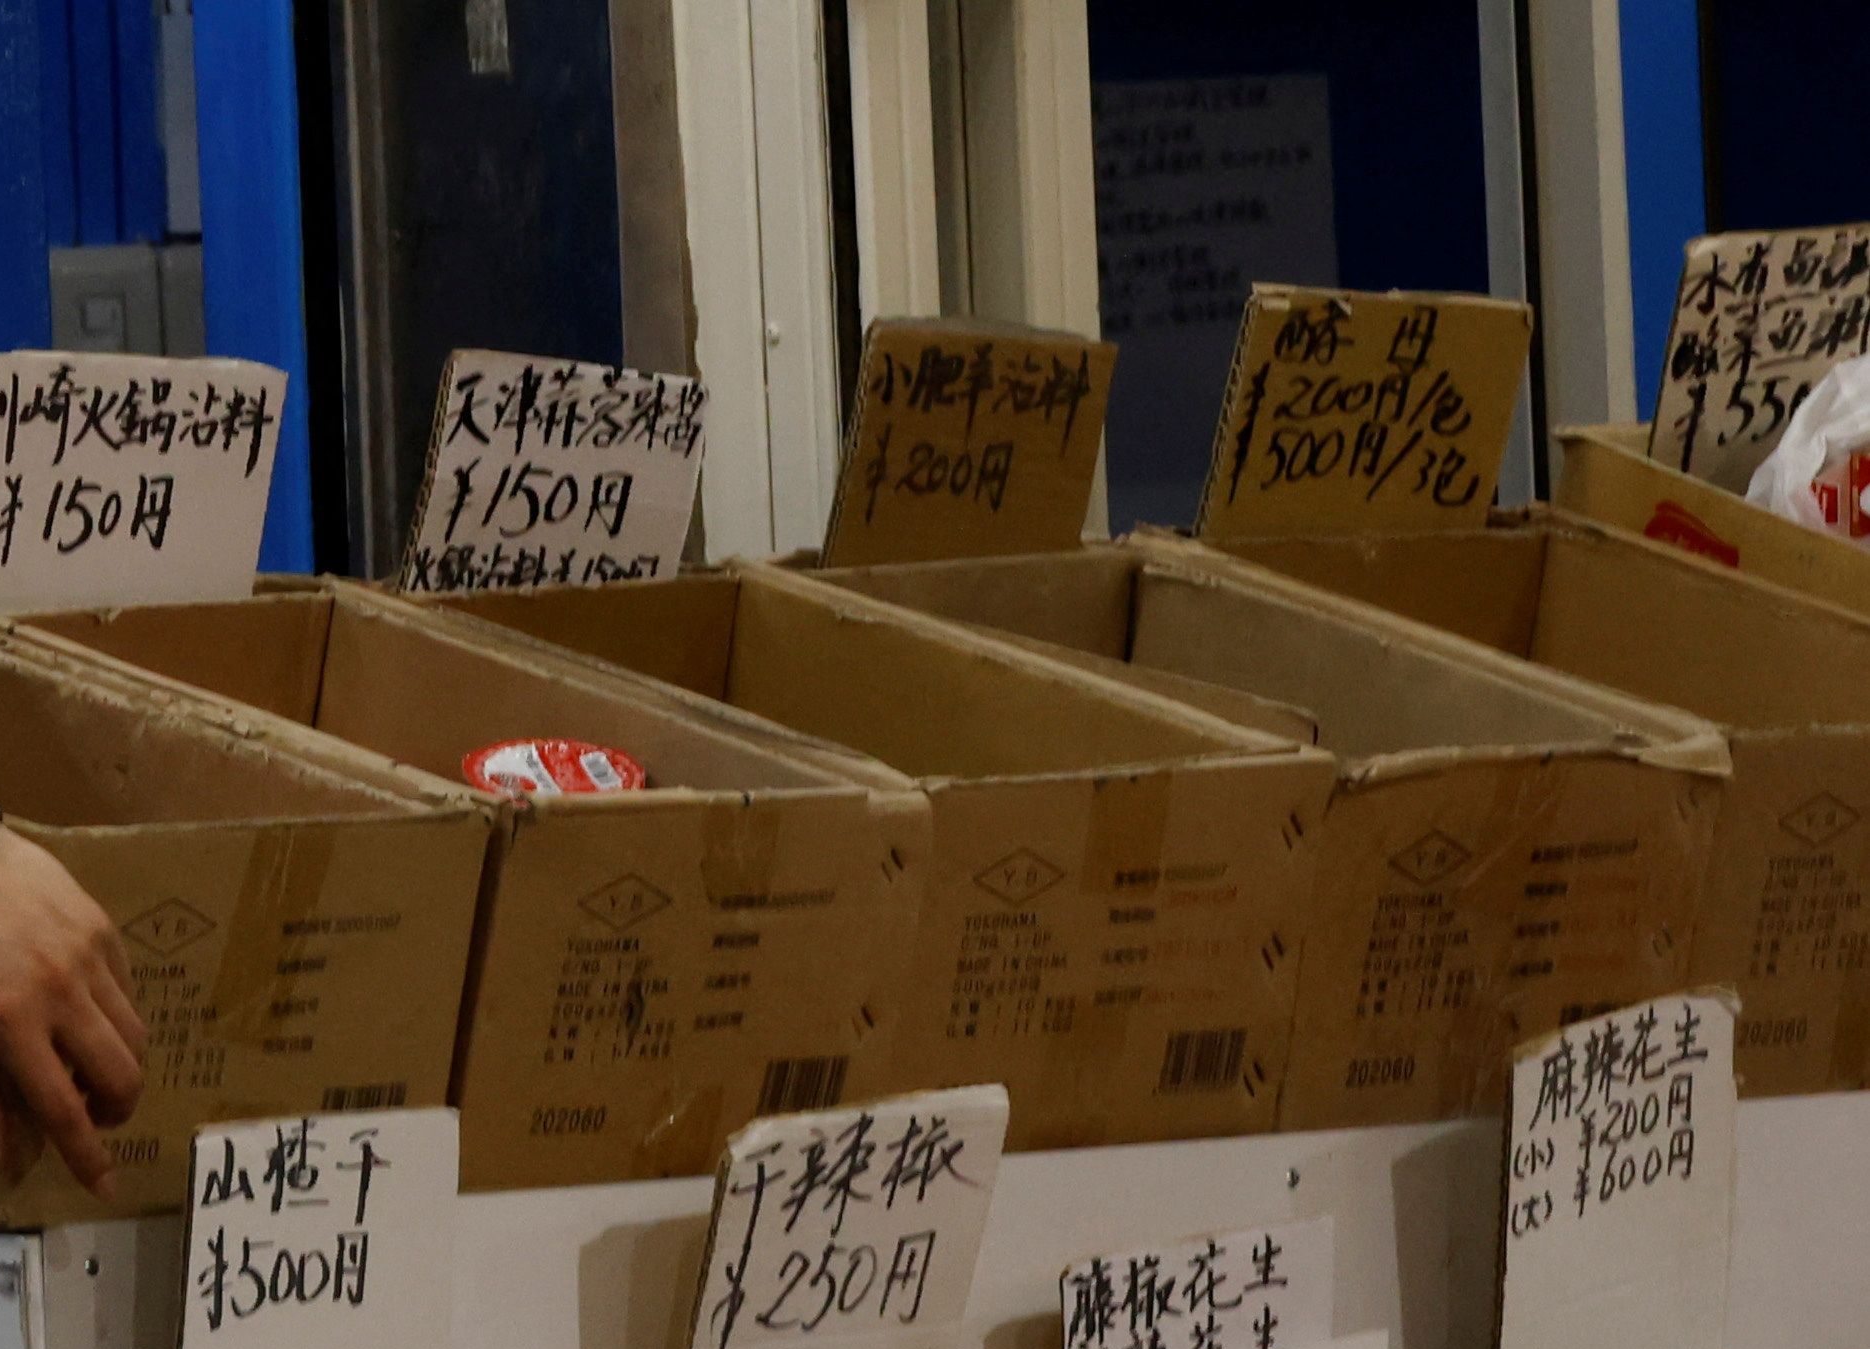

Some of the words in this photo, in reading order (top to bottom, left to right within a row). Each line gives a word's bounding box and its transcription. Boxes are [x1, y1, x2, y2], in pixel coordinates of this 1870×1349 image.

[443, 456, 634, 545] ¥150円
[862, 425, 1015, 525] ¥200円
[1528, 1005, 1710, 1131] 麻辣花生
[1513, 1137, 1554, 1180] (小)
[1577, 1073, 1694, 1172] ¥200円
[1511, 1191, 1553, 1239] (大)
[1572, 1130, 1696, 1220] ¥600円
[198, 1226, 370, 1332] ¥500円
